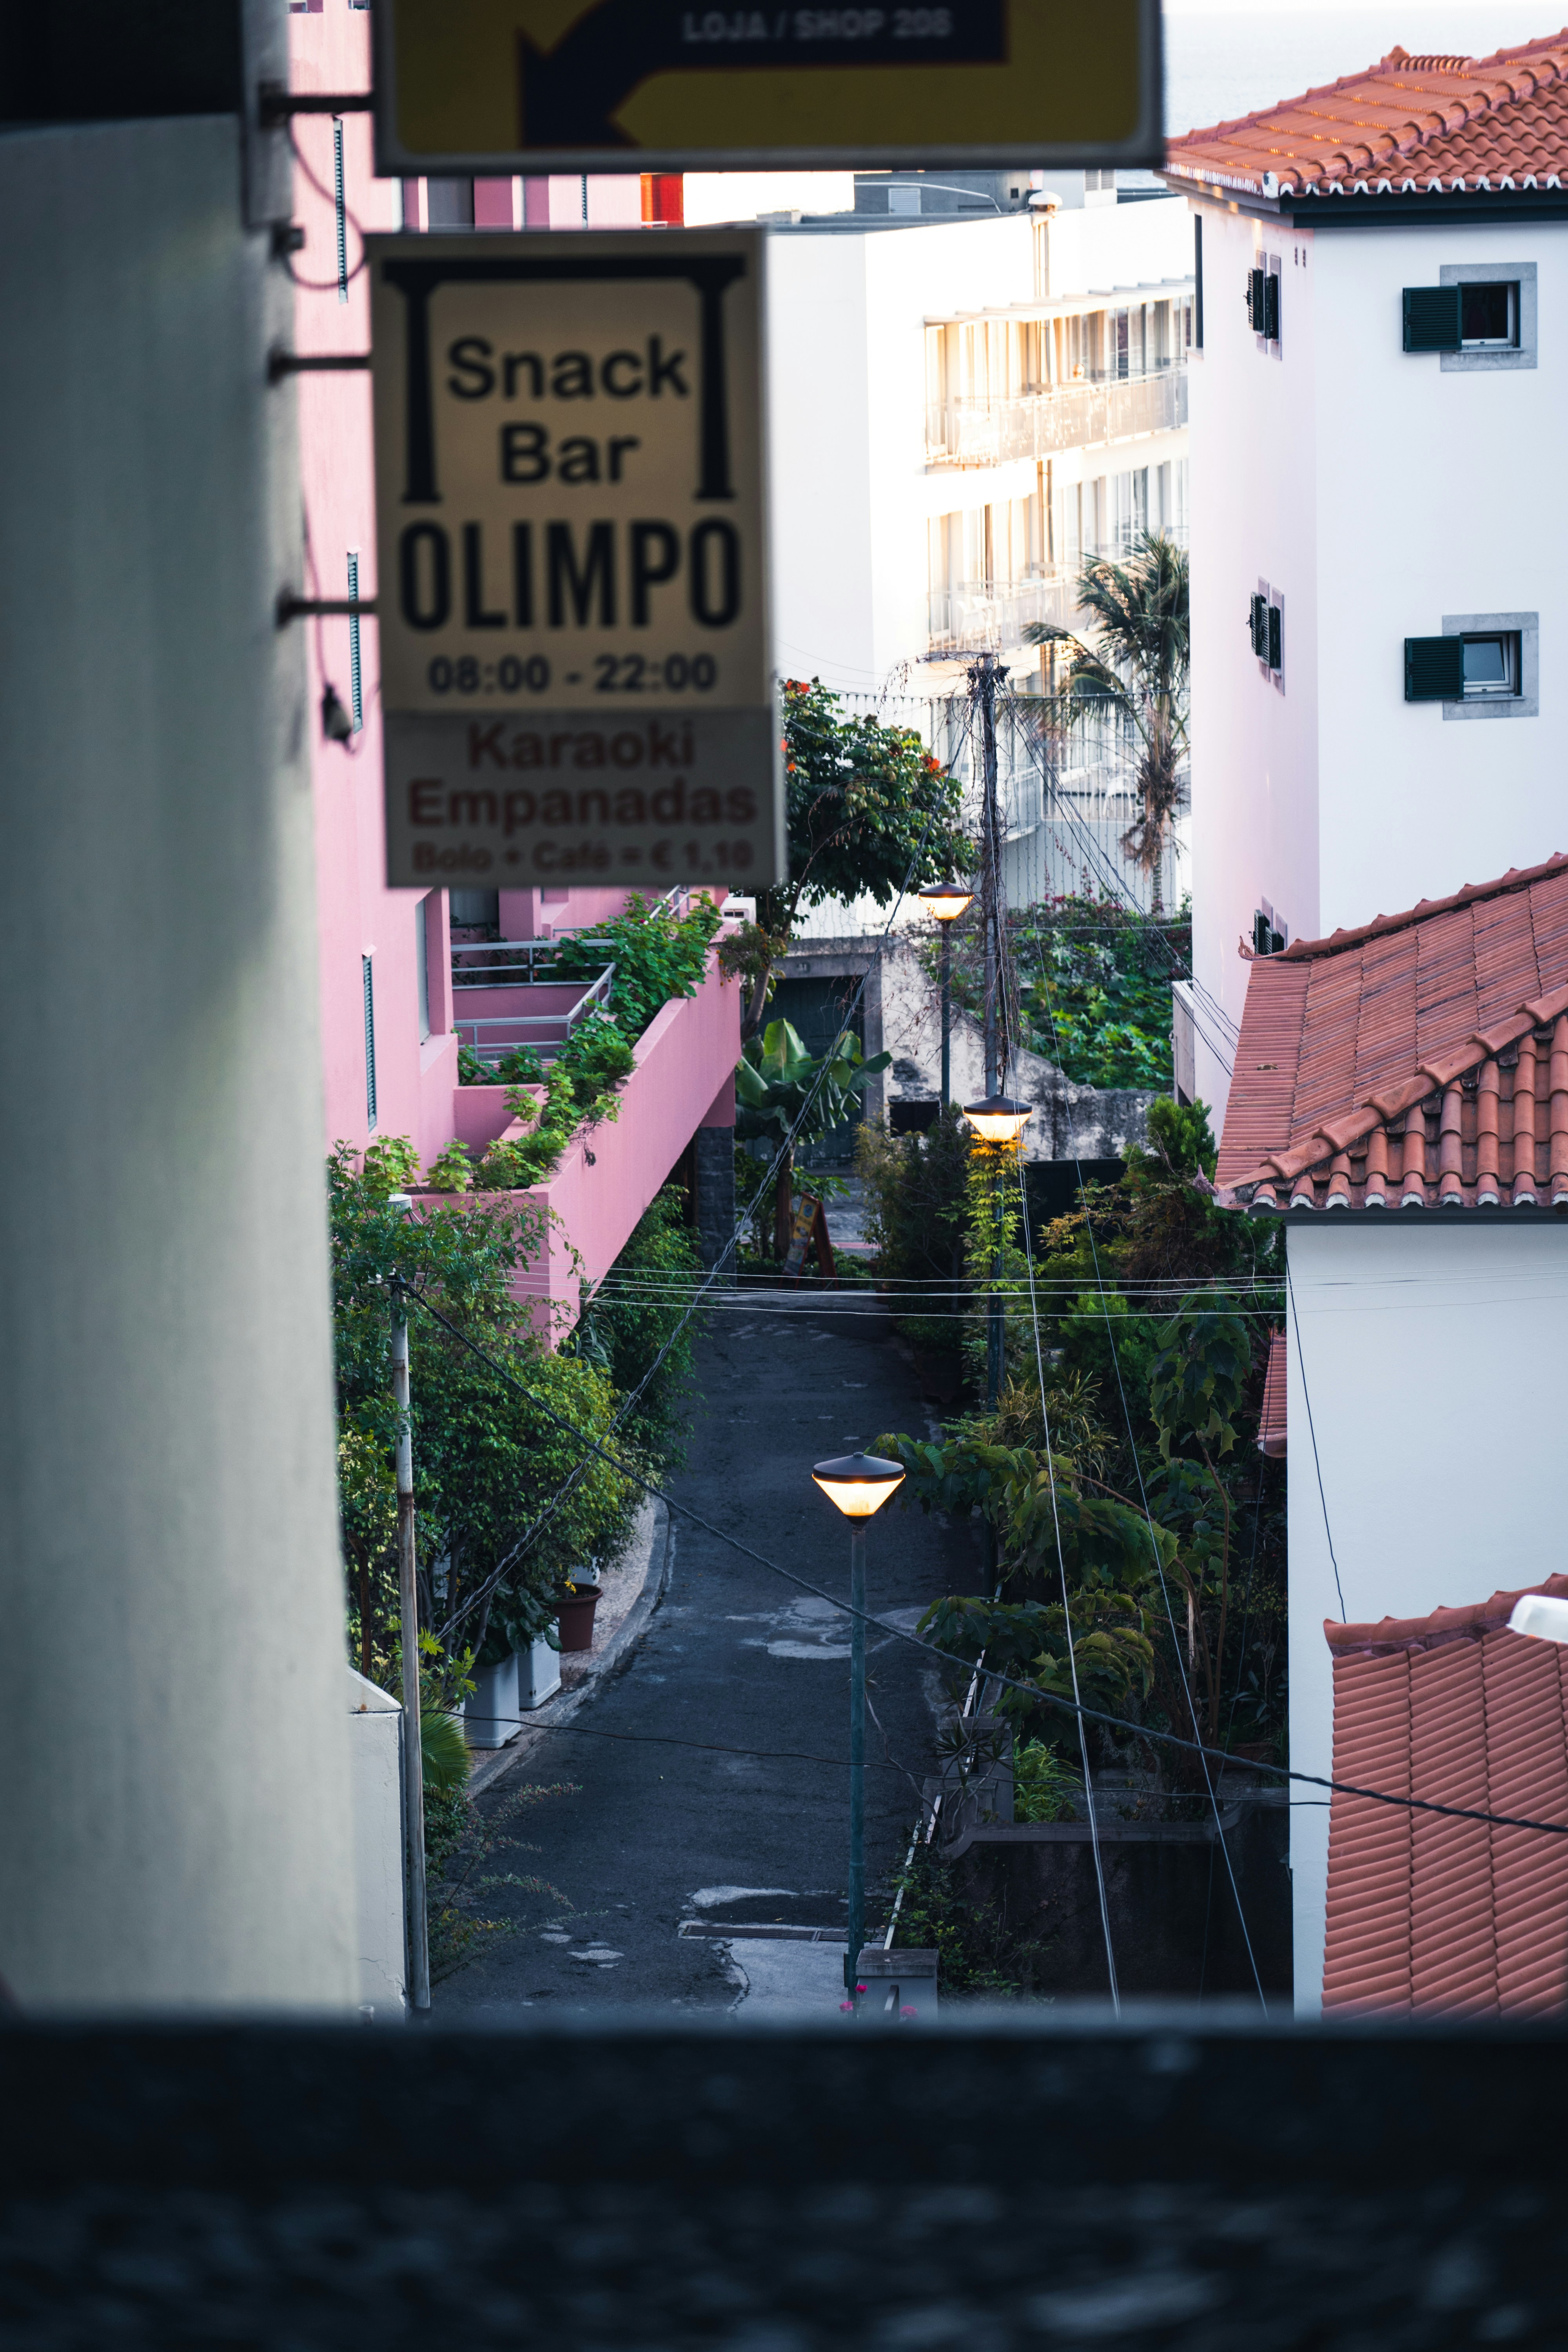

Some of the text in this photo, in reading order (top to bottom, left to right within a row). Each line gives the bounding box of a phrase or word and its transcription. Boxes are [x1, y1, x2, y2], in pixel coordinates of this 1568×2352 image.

[682, 11, 767, 42] LOJA
[794, 9, 884, 40] SHOP
[446, 334, 689, 400] Snack
[499, 422, 640, 485] Bar
[399, 517, 742, 632] OLIMPO
[428, 655, 549, 694] 08:00
[593, 653, 717, 692] 22:00
[467, 719, 695, 769] Karaoki
[408, 776, 758, 837] Empanadas
[412, 840, 493, 872] Bolo
[532, 839, 612, 872] Café
